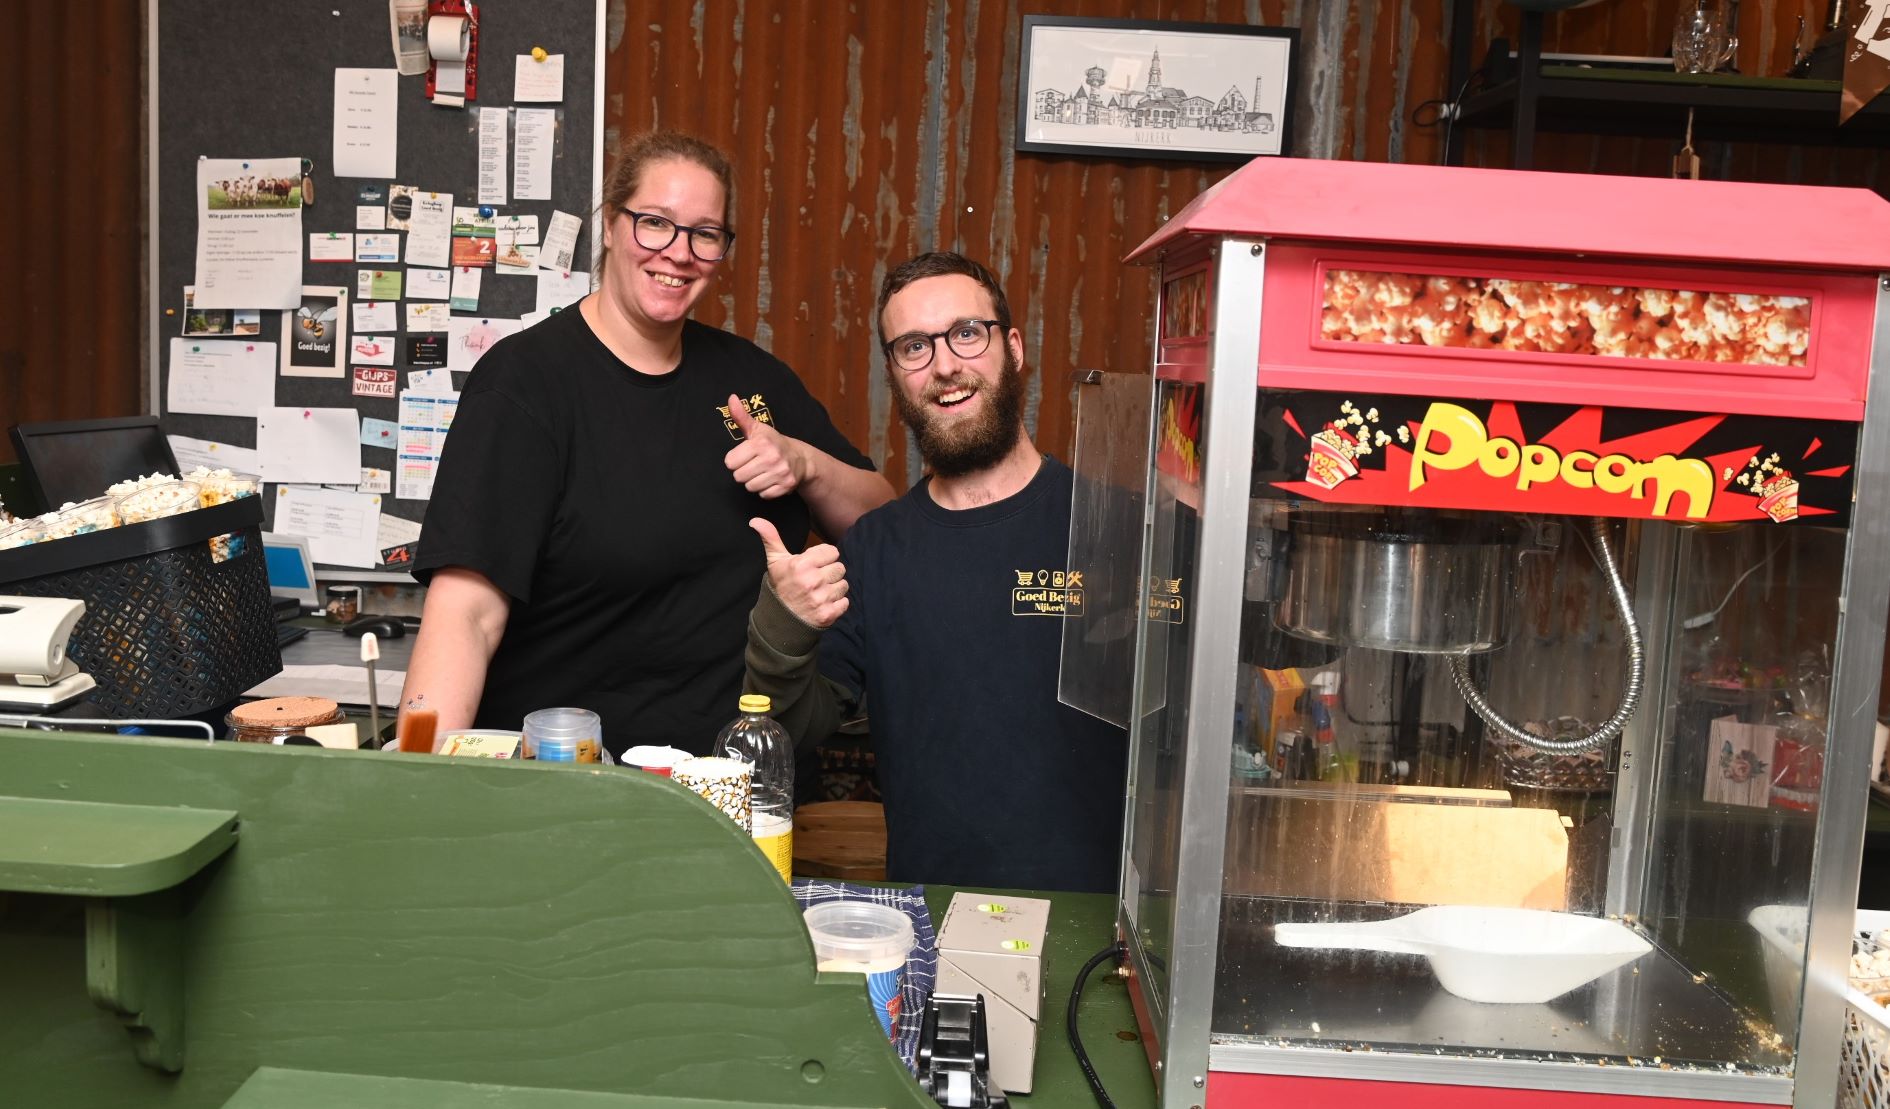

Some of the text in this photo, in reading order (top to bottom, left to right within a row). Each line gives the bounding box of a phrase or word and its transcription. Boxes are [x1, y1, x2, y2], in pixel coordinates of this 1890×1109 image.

[1135, 130, 1172, 145] NIJKERK
[479, 240, 491, 254] 2
[298, 341, 331, 353] Goed bezig!
[356, 382, 393, 394] VINTAGE
[1313, 452, 1338, 469] POP
[1408, 402, 1715, 519] Popcorn
[1313, 464, 1338, 484] CORN
[1769, 496, 1788, 512] POP
[1775, 507, 1797, 518] CORN
[1015, 590, 1081, 606] Goed Bezig
[1034, 602, 1066, 613] Nijkerk
